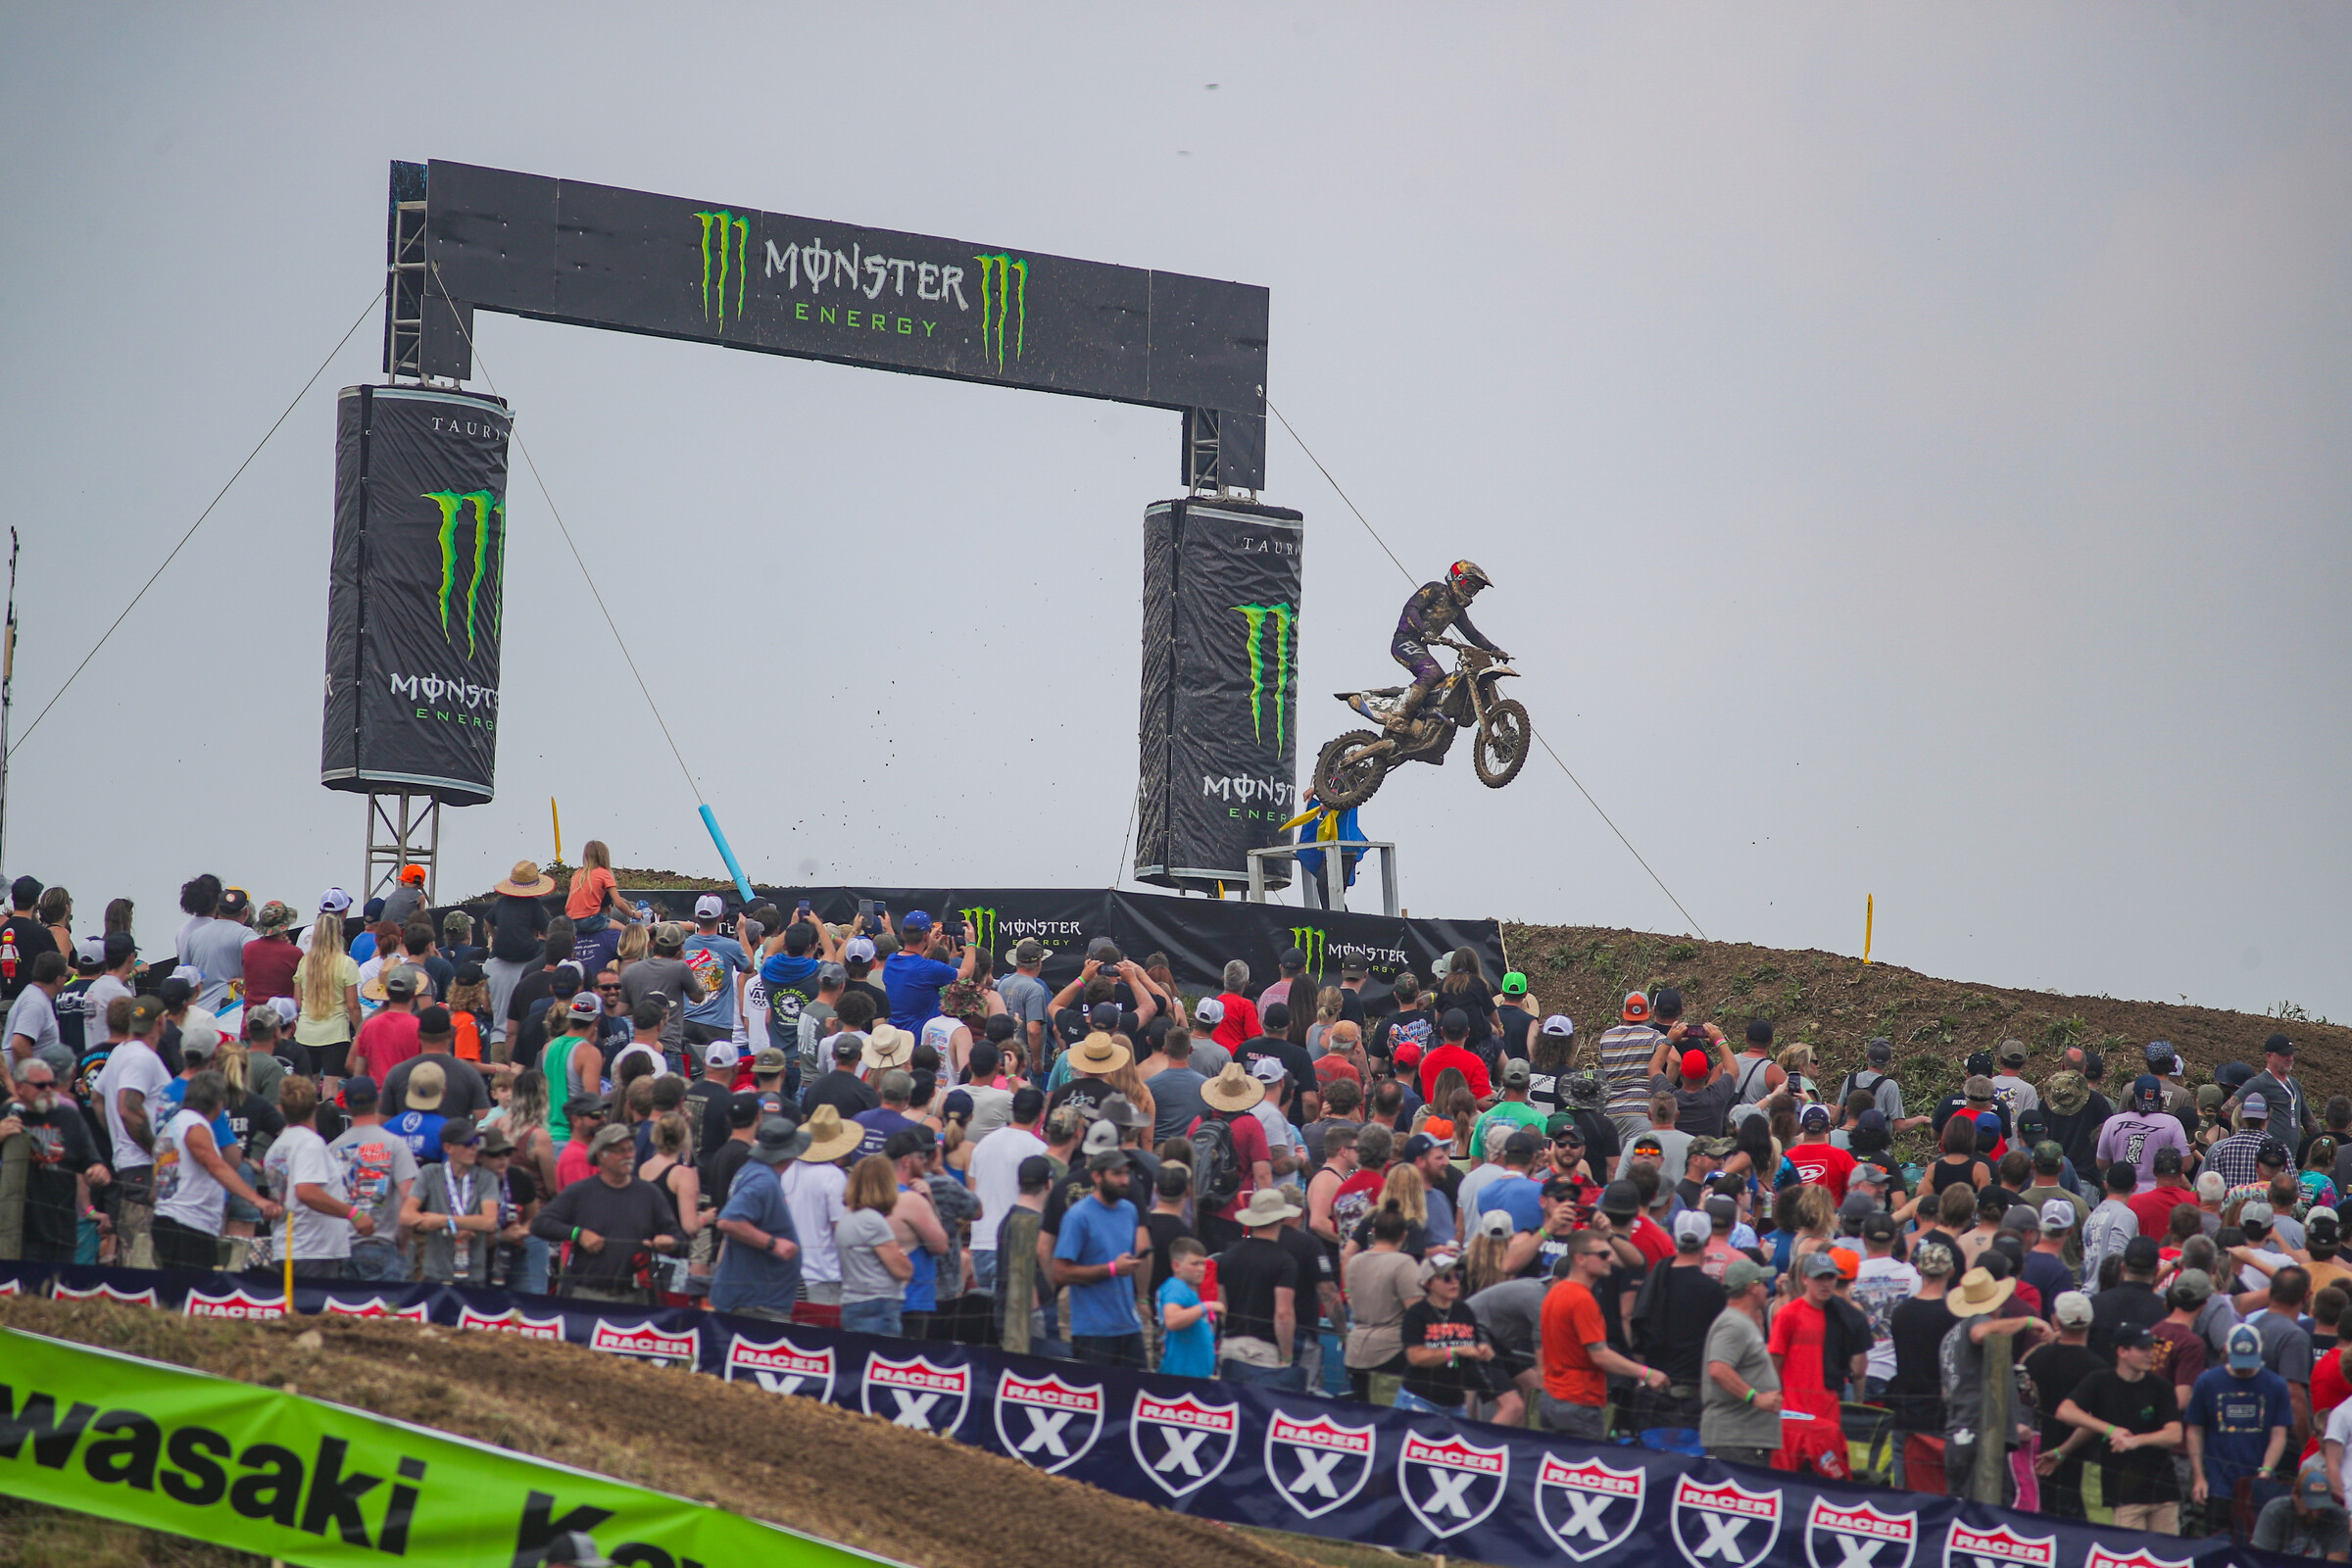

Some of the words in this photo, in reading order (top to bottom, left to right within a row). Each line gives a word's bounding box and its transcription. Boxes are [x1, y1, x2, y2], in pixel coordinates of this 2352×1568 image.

[764, 237, 969, 312] MONSTER
[795, 302, 937, 337] ENERGY
[999, 918, 1082, 937] MONSTER
[601, 1334, 690, 1354] RACER
[738, 1348, 825, 1373] RACER
[872, 1367, 962, 1392] RACER
[1006, 1385, 1095, 1409] RACER
[1141, 1403, 1231, 1430] RACER
[1017, 1406, 1075, 1458] X
[1276, 1425, 1367, 1451] RACER
[1153, 1425, 1209, 1478] X
[1409, 1445, 1500, 1471] RACER
[1288, 1446, 1346, 1499] X
[1545, 1467, 1637, 1494] RACER
[1421, 1466, 1478, 1519] X
[1683, 1489, 1773, 1515] RACER
[1557, 1490, 1615, 1543] X
[1818, 1510, 1908, 1537] RACER
[1693, 1511, 1751, 1564] X
[1955, 1533, 2046, 1561] RACER
